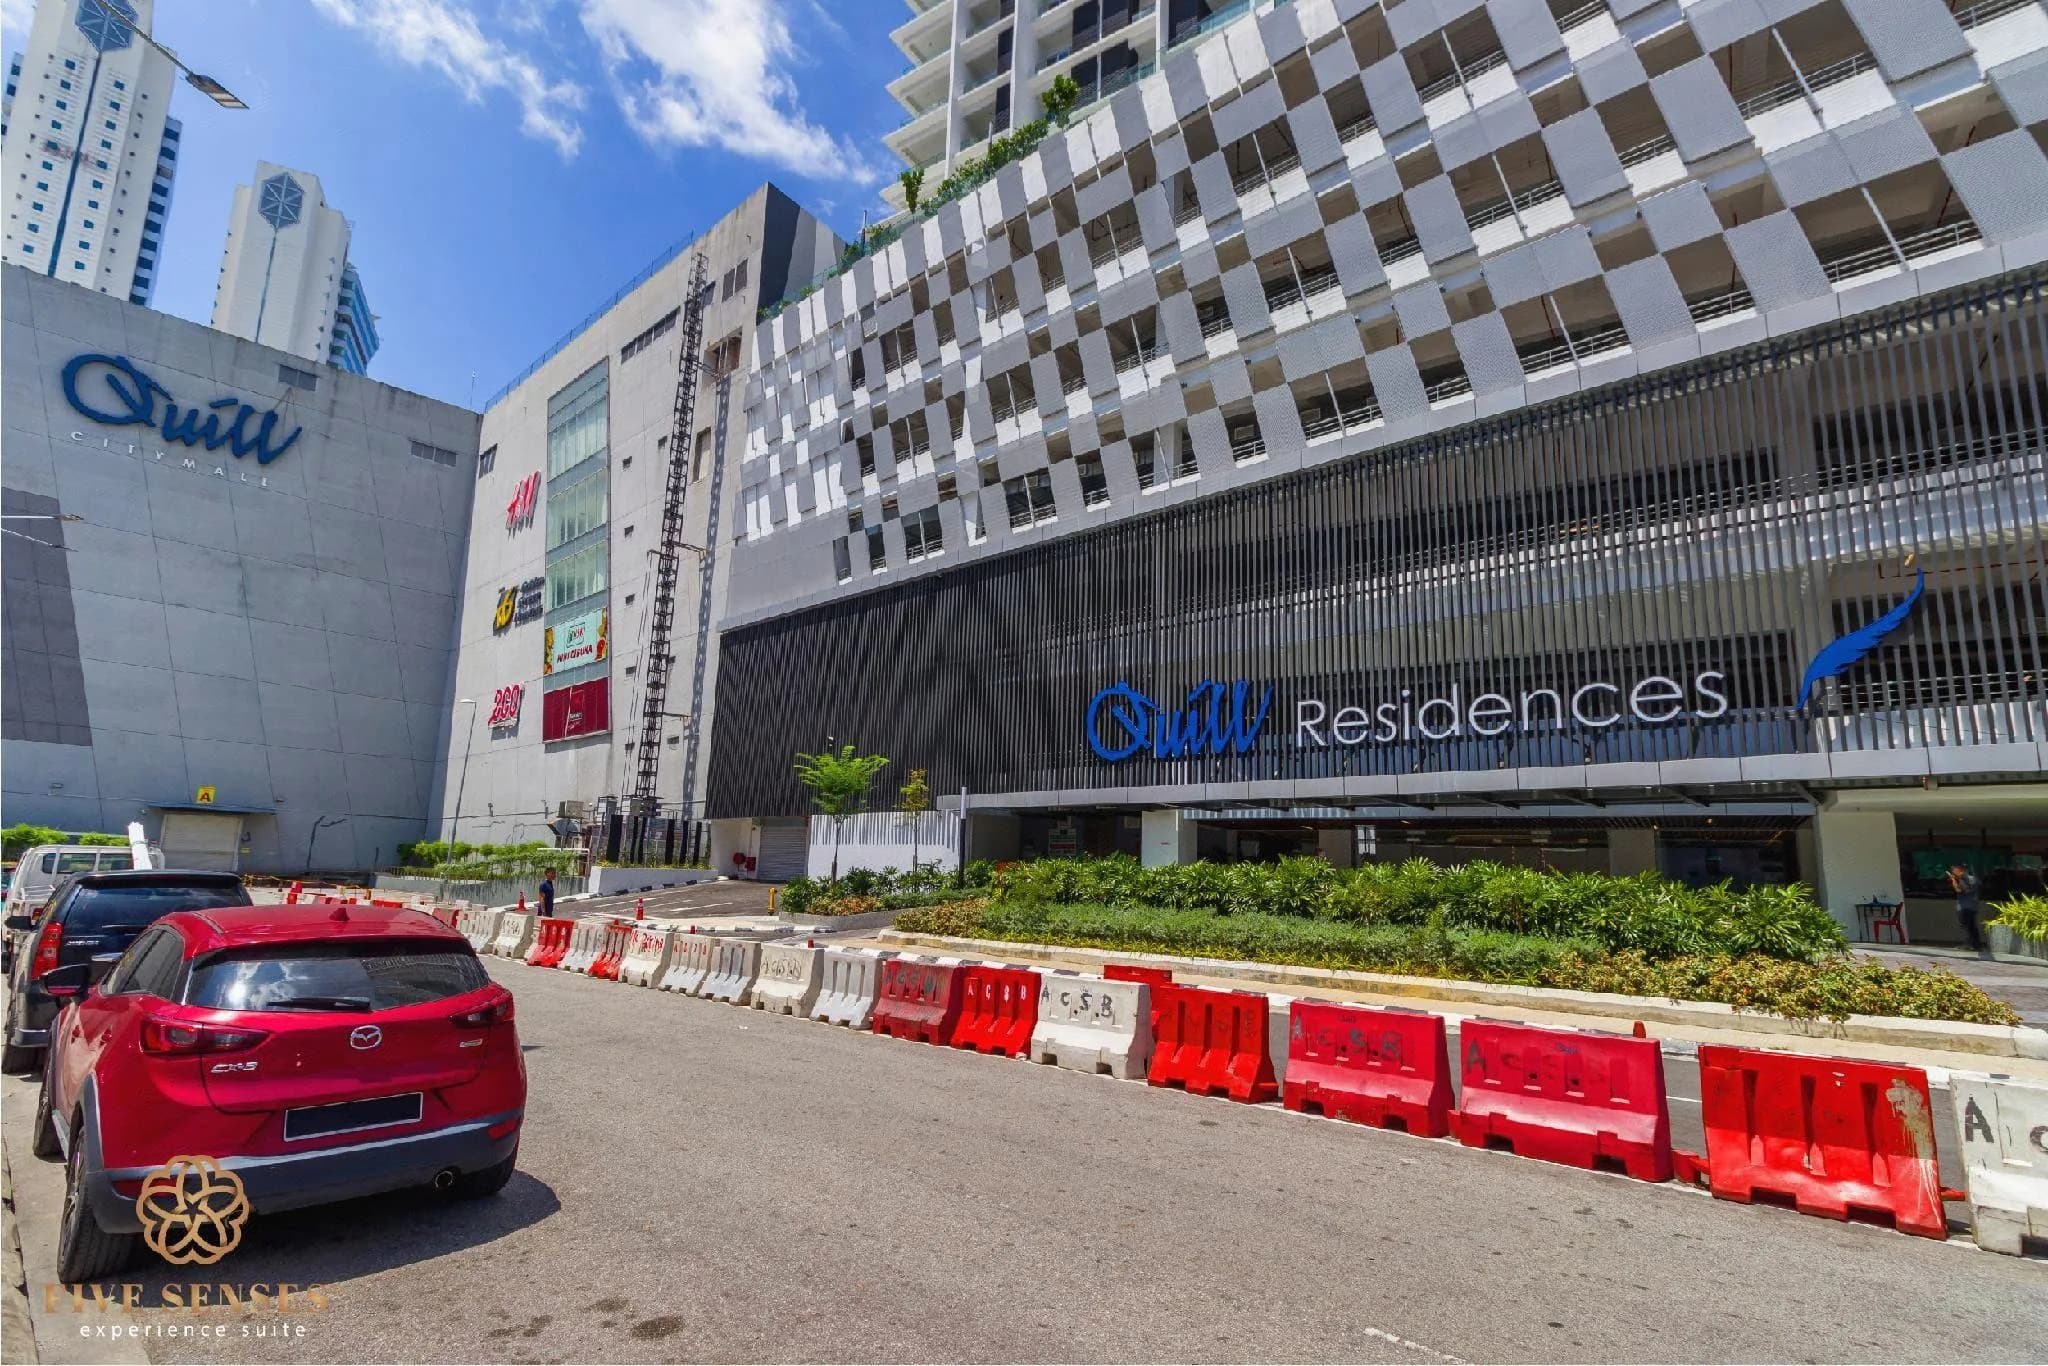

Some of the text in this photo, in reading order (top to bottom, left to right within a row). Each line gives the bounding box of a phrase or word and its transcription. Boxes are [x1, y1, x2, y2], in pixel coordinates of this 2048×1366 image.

[61, 353, 303, 464] Quill
[1087, 670, 1728, 761] Quill Residences
[199, 792, 211, 803] A
